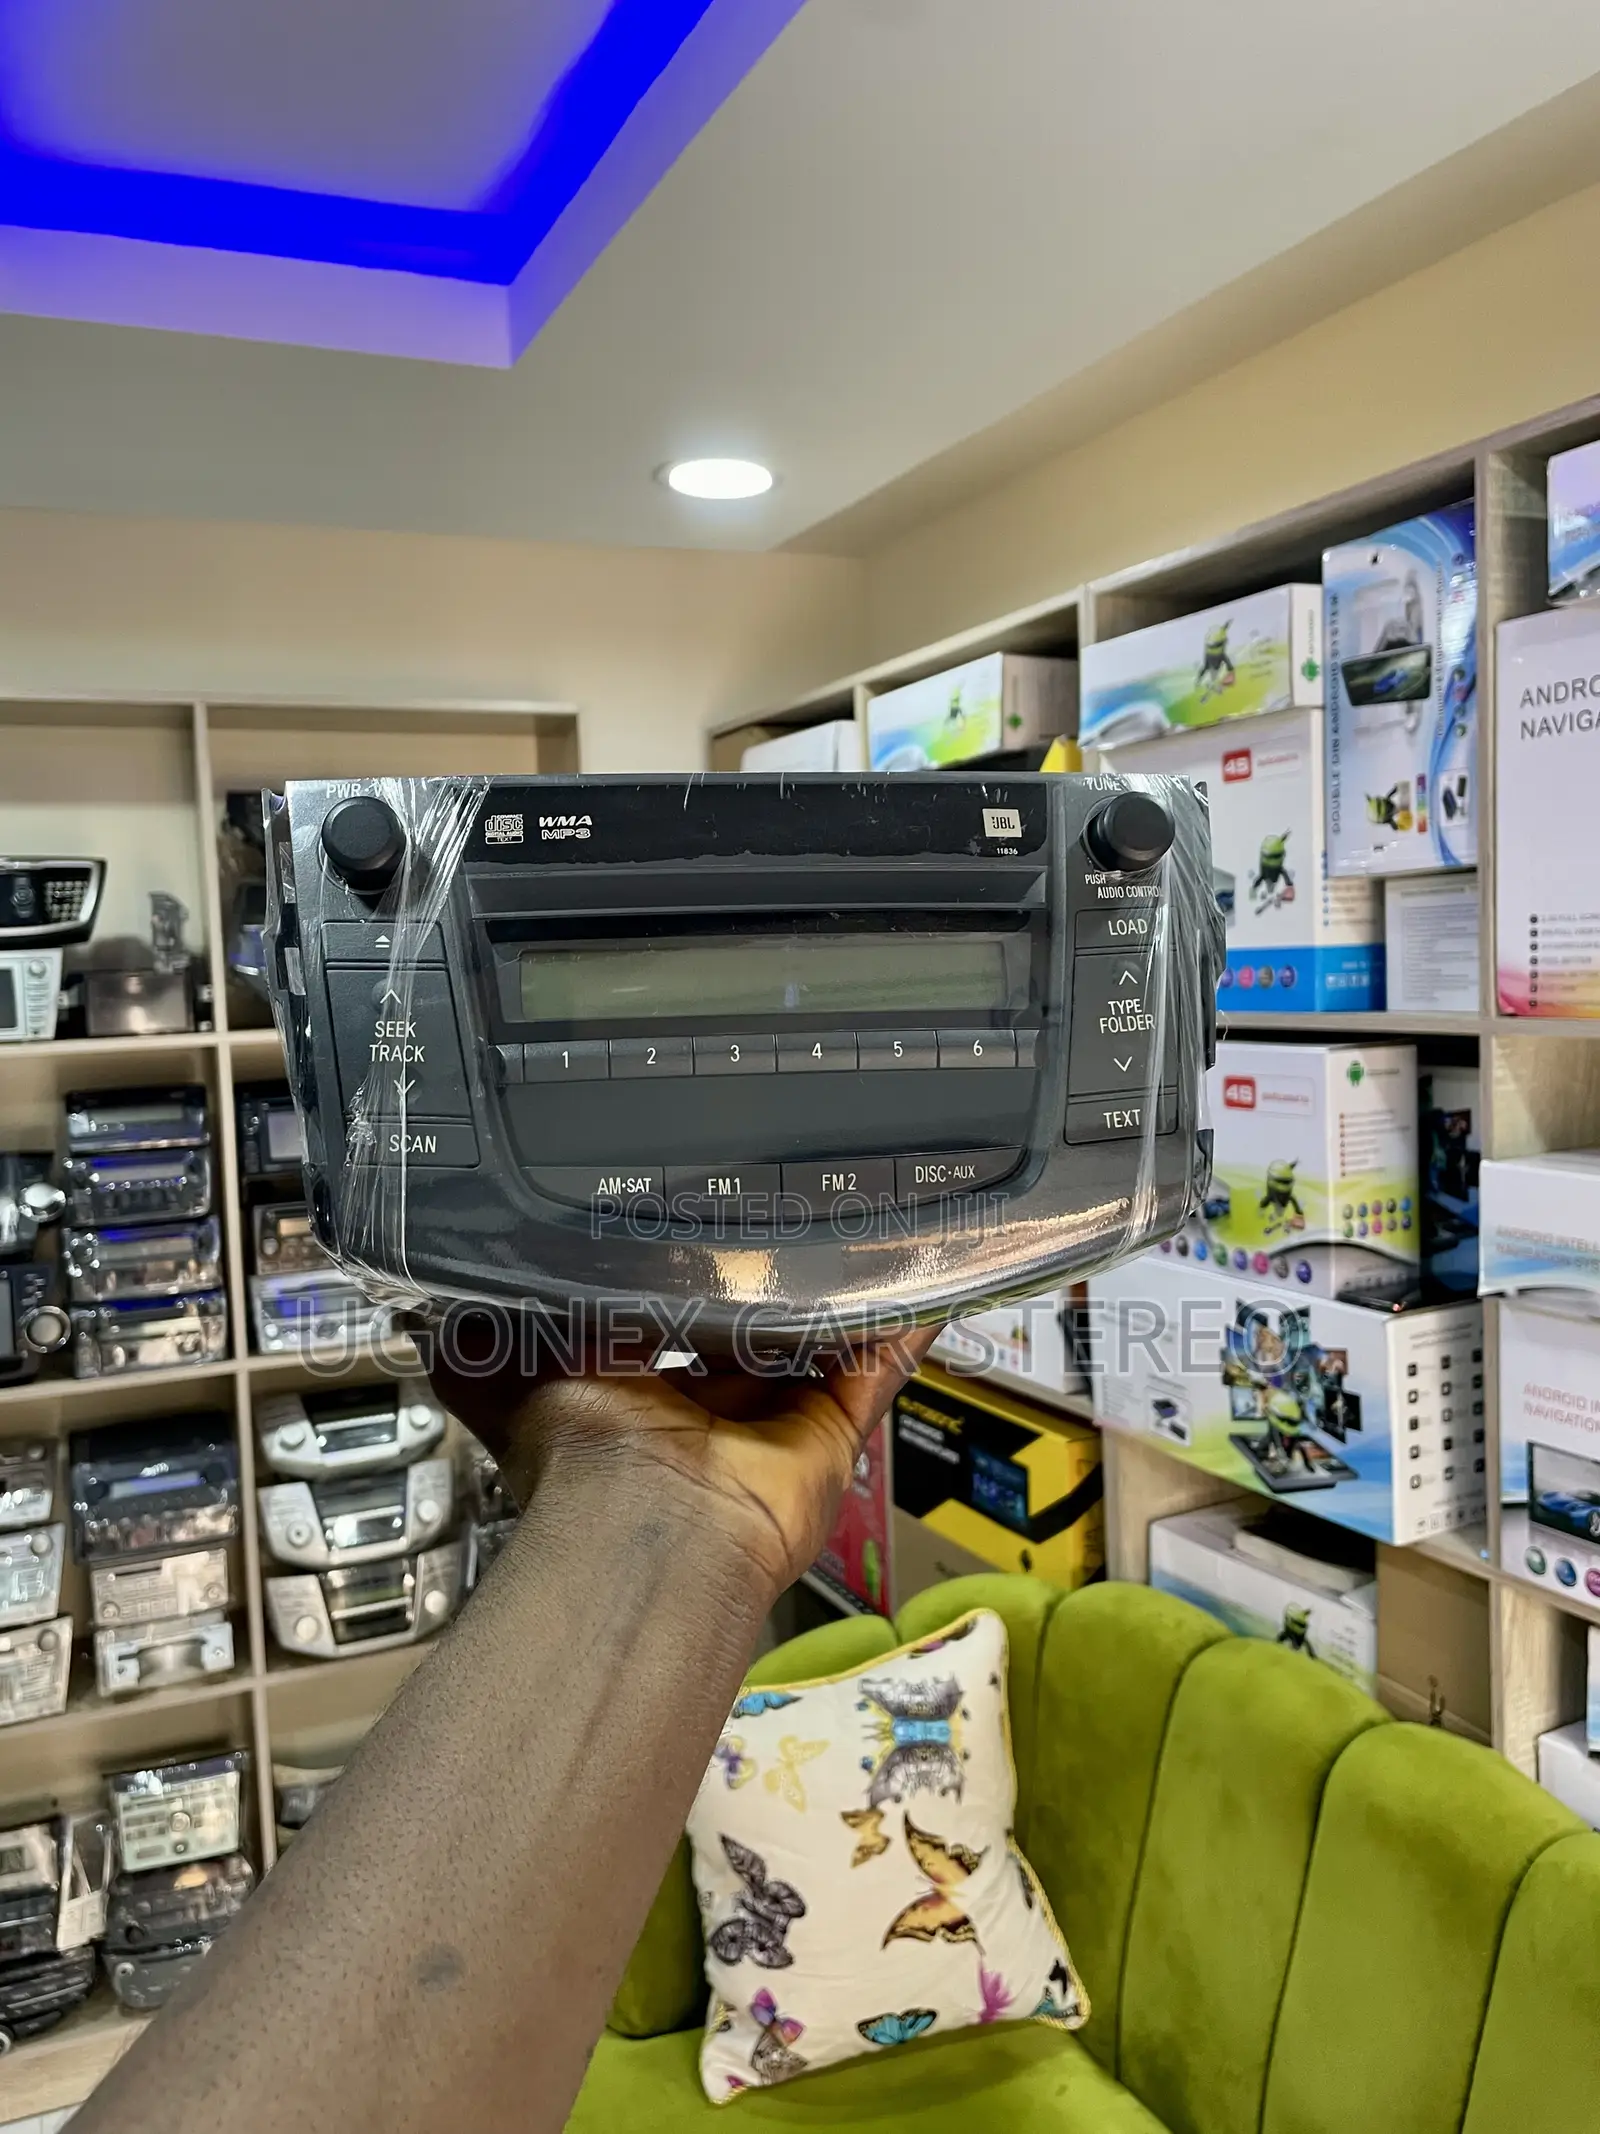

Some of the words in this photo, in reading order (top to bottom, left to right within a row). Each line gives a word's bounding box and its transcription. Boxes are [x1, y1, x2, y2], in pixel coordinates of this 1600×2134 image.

[1519, 674, 1600, 708] ANDRO
[1083, 776, 1122, 791] TUNE
[539, 815, 593, 827] WMA
[991, 816, 1016, 830] JBL
[541, 828, 592, 840] MP3
[996, 847, 1019, 855] 11836
[1084, 874, 1107, 885] PUSH
[1097, 886, 1125, 899] AUDIO
[1107, 918, 1148, 936] LOAD
[1107, 998, 1142, 1016] TYPE
[374, 1020, 417, 1038] SEEK
[1099, 1014, 1156, 1034] FOLDER
[369, 1044, 425, 1063] TRACK
[646, 1047, 656, 1065] 2
[730, 1044, 740, 1062] 3
[811, 1042, 823, 1060] 4
[893, 1041, 903, 1058] 5
[973, 1039, 983, 1057] 6
[562, 1050, 569, 1069] 1
[1103, 1108, 1141, 1129] TEXT
[389, 1133, 437, 1154] SCAN
